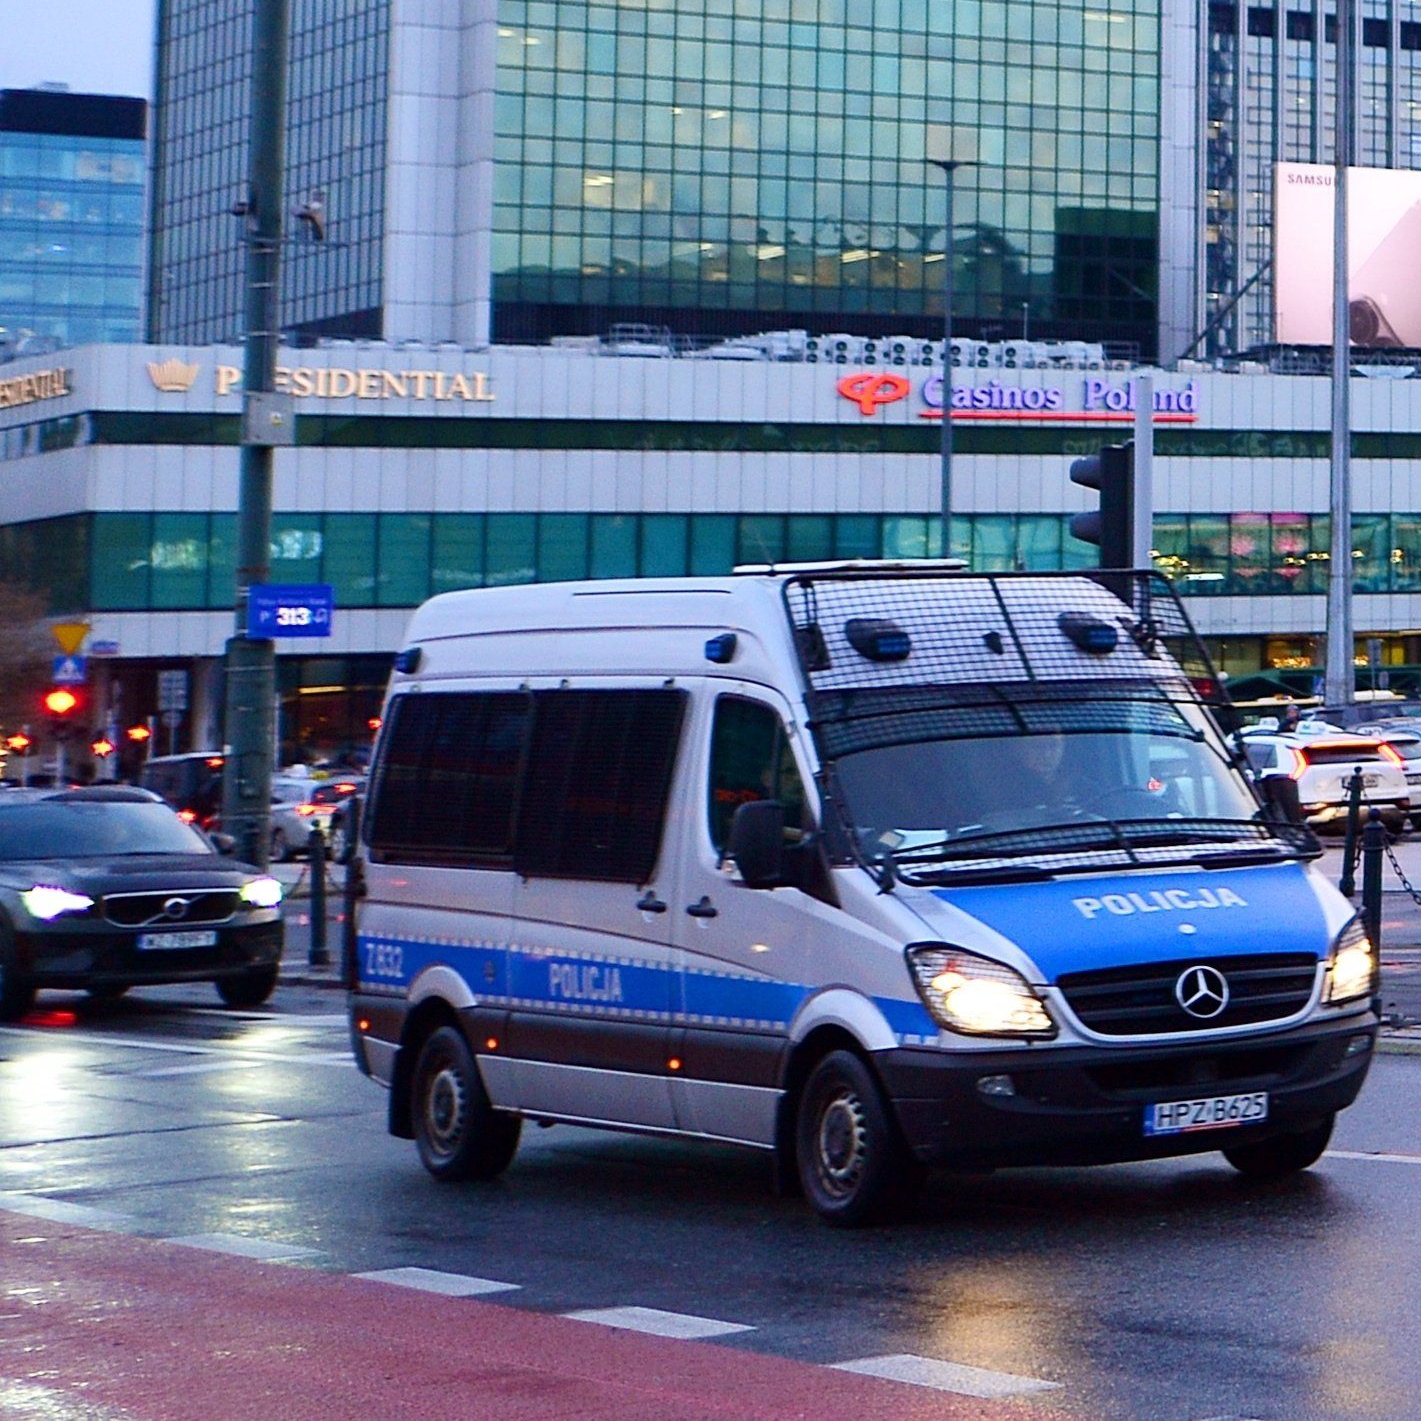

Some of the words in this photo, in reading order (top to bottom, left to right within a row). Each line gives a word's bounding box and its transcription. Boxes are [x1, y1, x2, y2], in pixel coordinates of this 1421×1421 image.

[1287, 173, 1333, 186] SAMSU
[216, 365, 496, 401] PESIDENTIAL
[923, 378, 1062, 409] Casinos
[1084, 379, 1197, 412] Polnd
[277, 607, 311, 625] 313
[1073, 888, 1248, 919] POLICJA
[551, 963, 623, 1003] POLICJA
[1158, 1101, 1207, 1128] HPZ
